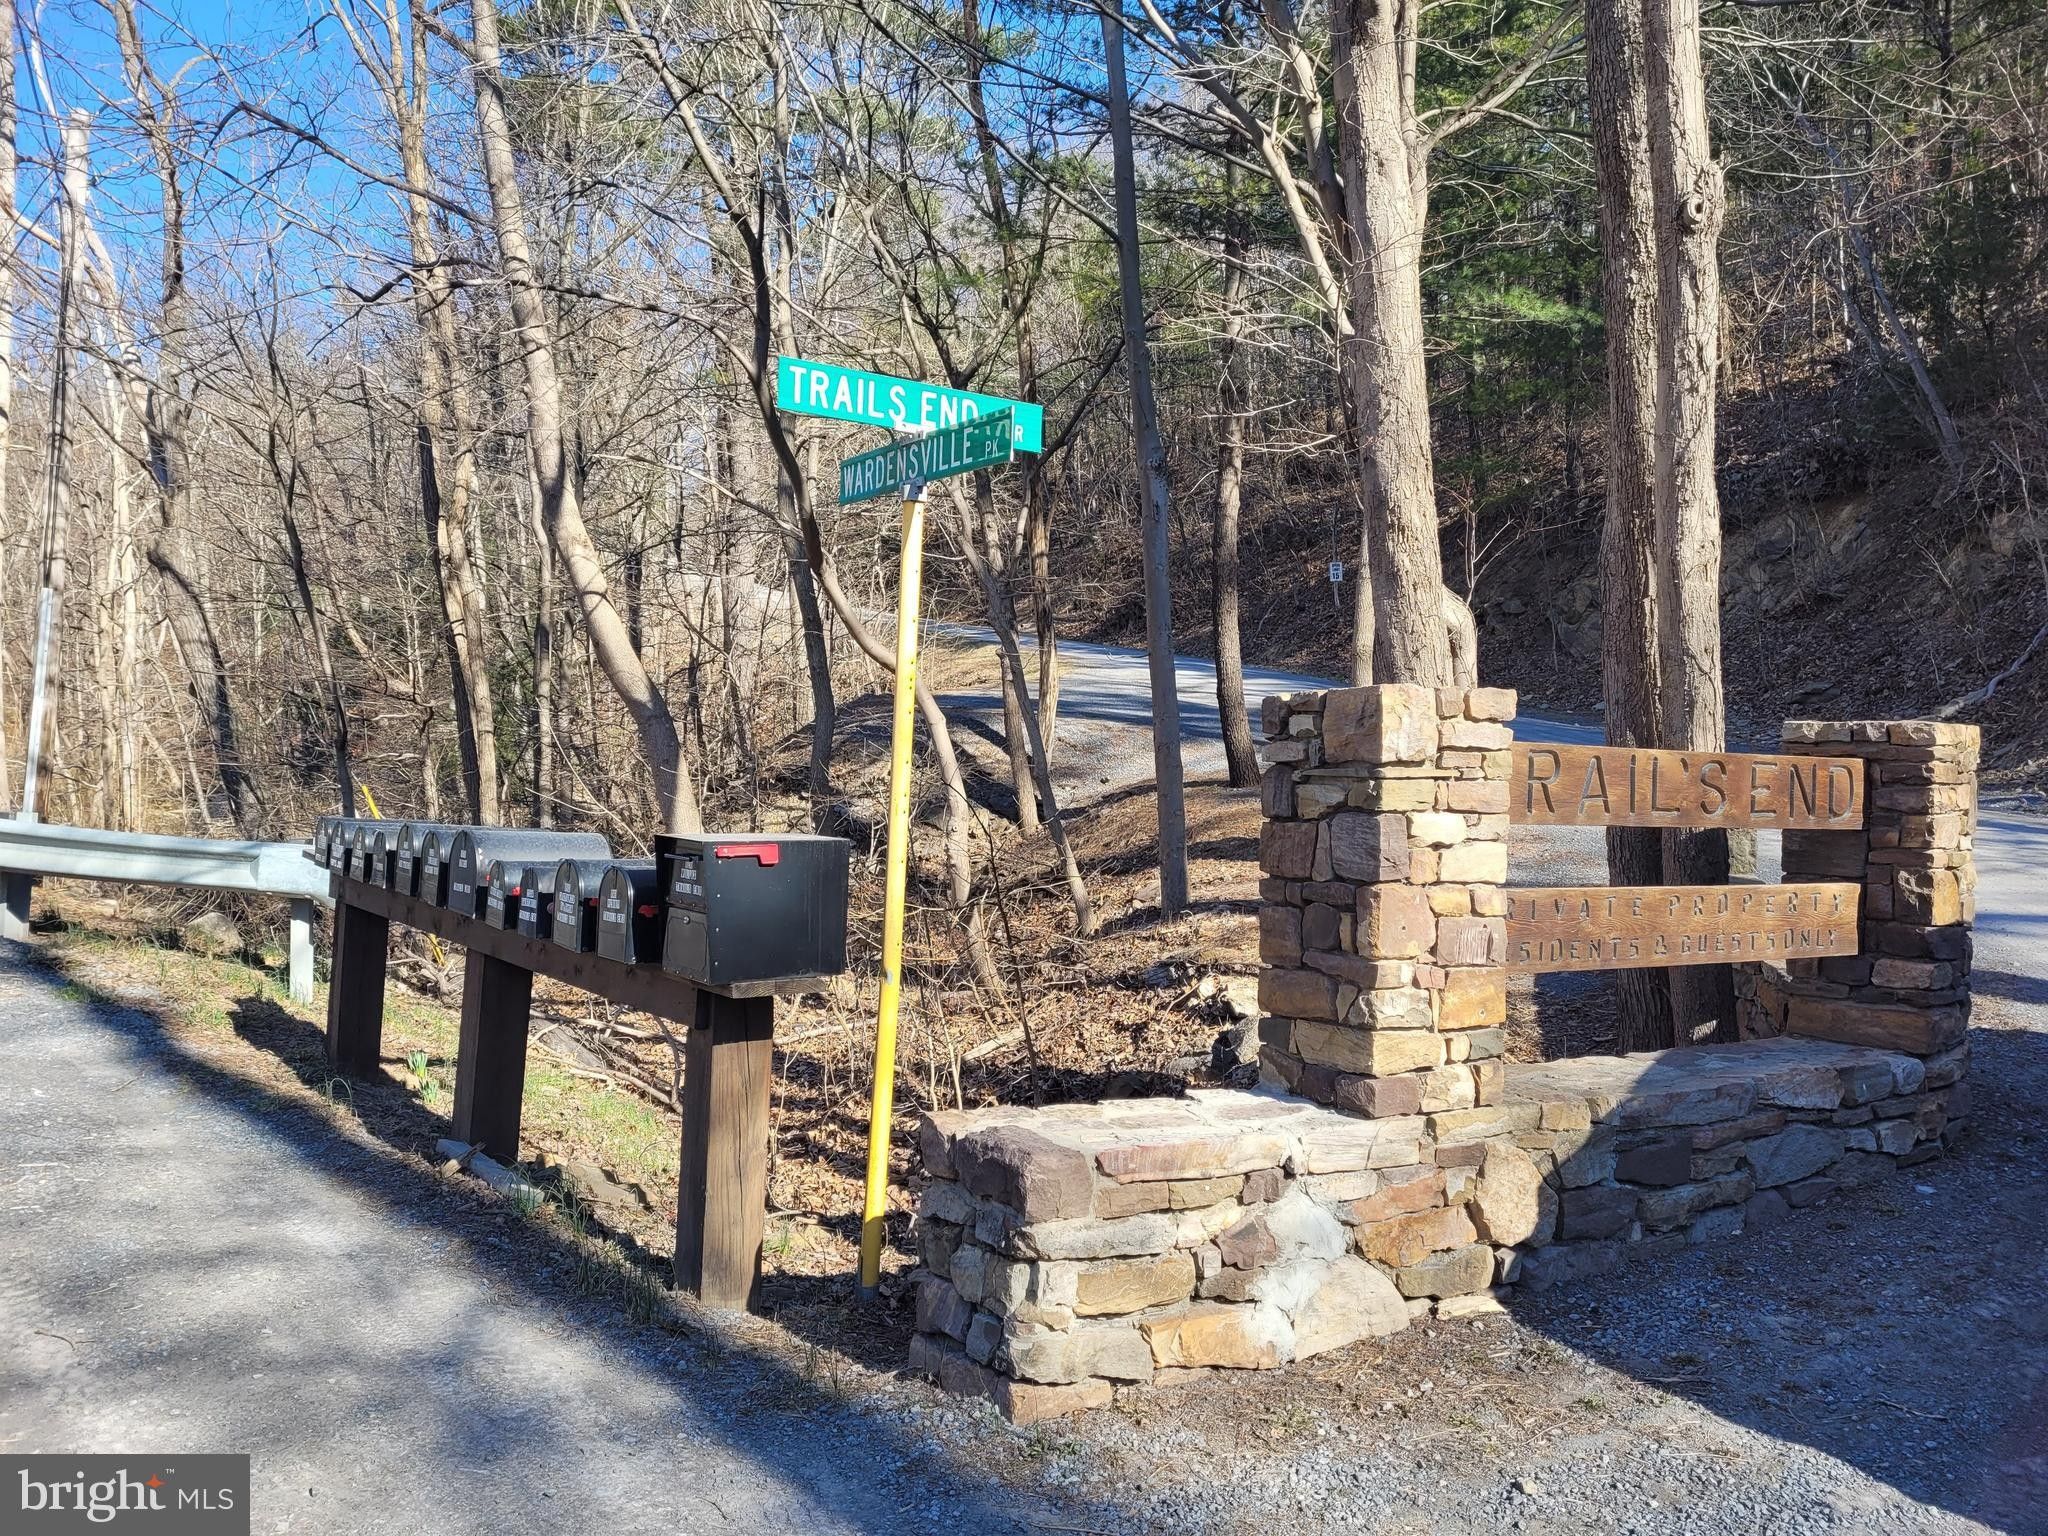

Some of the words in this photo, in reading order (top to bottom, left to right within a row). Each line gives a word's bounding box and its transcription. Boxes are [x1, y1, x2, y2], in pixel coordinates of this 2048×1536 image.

[789, 365, 906, 424] TRAILS
[921, 391, 979, 429] END
[1014, 424, 1024, 443] R
[844, 427, 973, 498] WARDENSVILLE
[985, 438, 999, 459] PK
[1527, 748, 1728, 818] RAIL'S
[1750, 760, 1855, 822] END
[1506, 896, 1643, 920] RIVATE
[1668, 891, 1844, 919] PROPERTY
[1506, 938, 1640, 965] SIDENTS
[1681, 931, 1775, 954] GUESTS
[1783, 928, 1839, 950] ONLY
